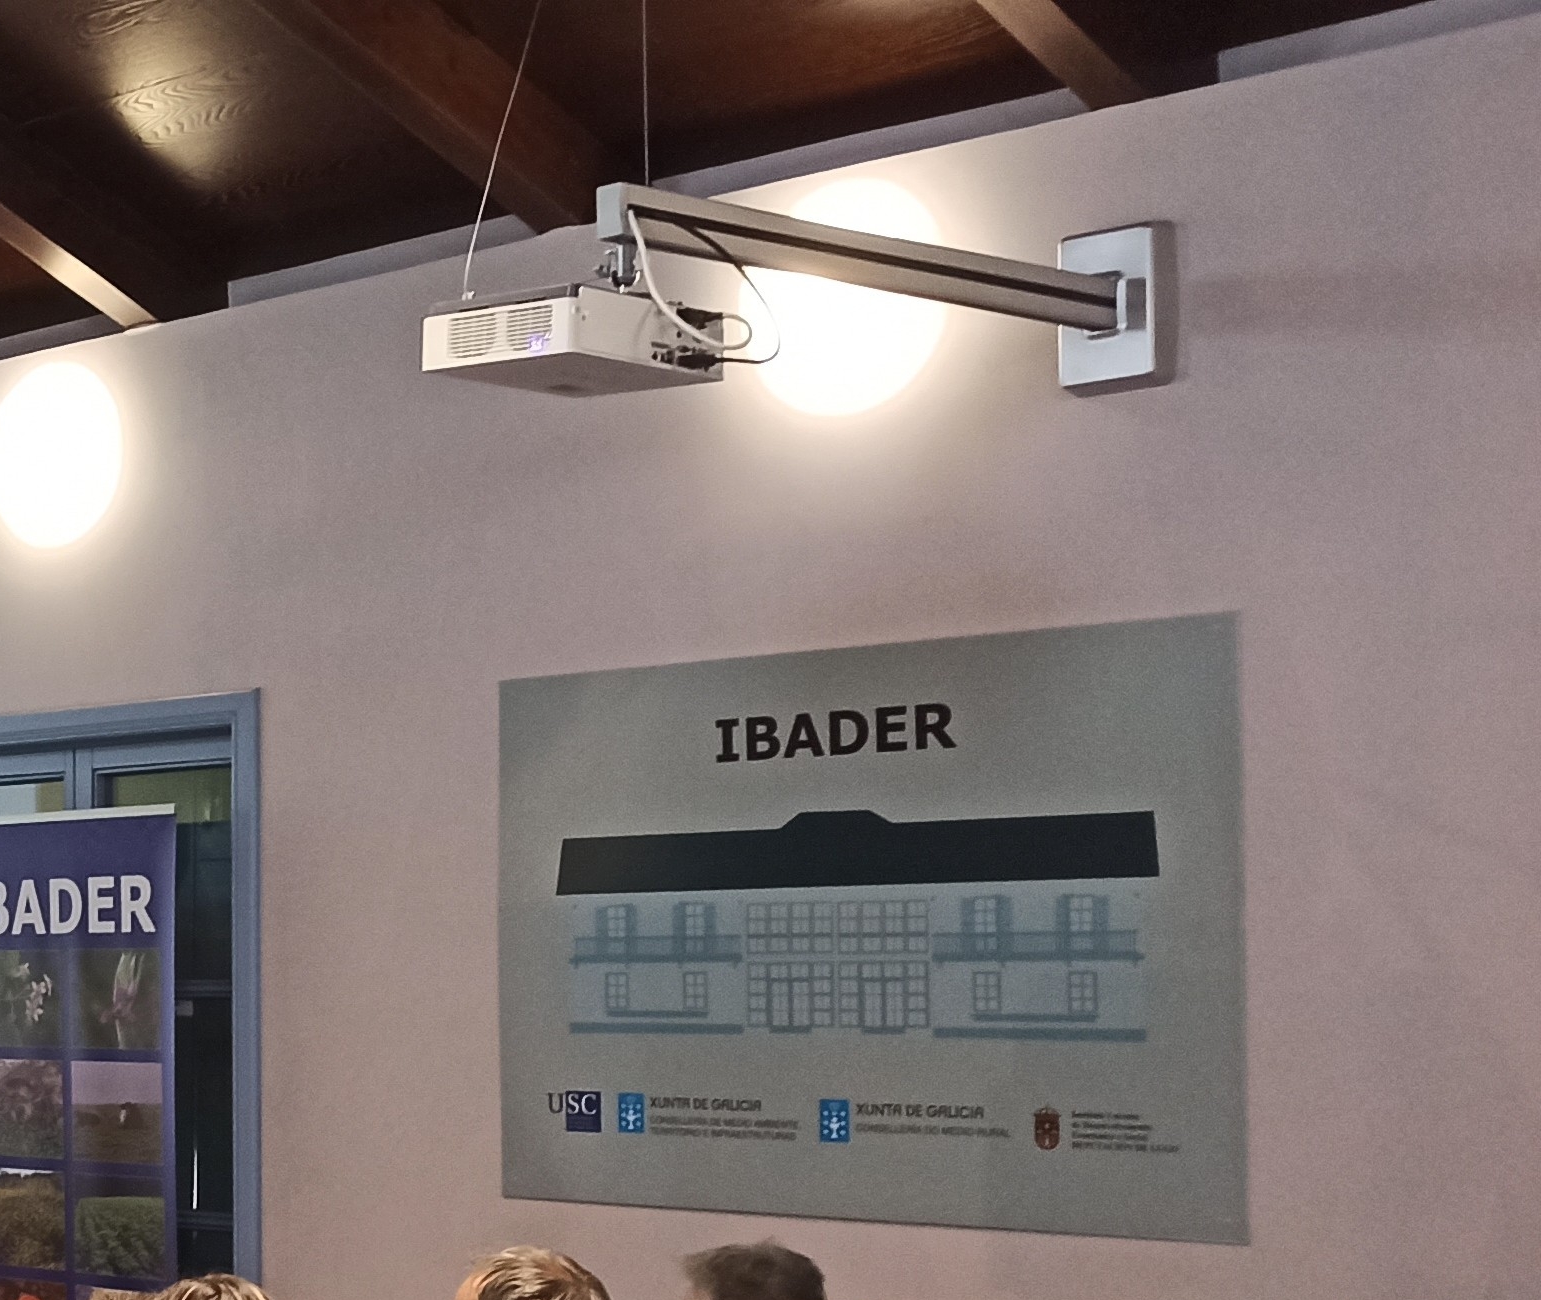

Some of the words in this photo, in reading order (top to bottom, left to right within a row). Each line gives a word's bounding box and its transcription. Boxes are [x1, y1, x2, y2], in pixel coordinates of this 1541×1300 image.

[715, 702, 957, 763] IBADER
[547, 1092, 598, 1115] USC
[650, 1097, 690, 1109] XUNTA
[693, 1098, 709, 1110] DE
[710, 1098, 762, 1112] GALICIA
[855, 1103, 902, 1117] XUNTA
[905, 1104, 922, 1118] DE
[926, 1105, 984, 1119] GALICIA
